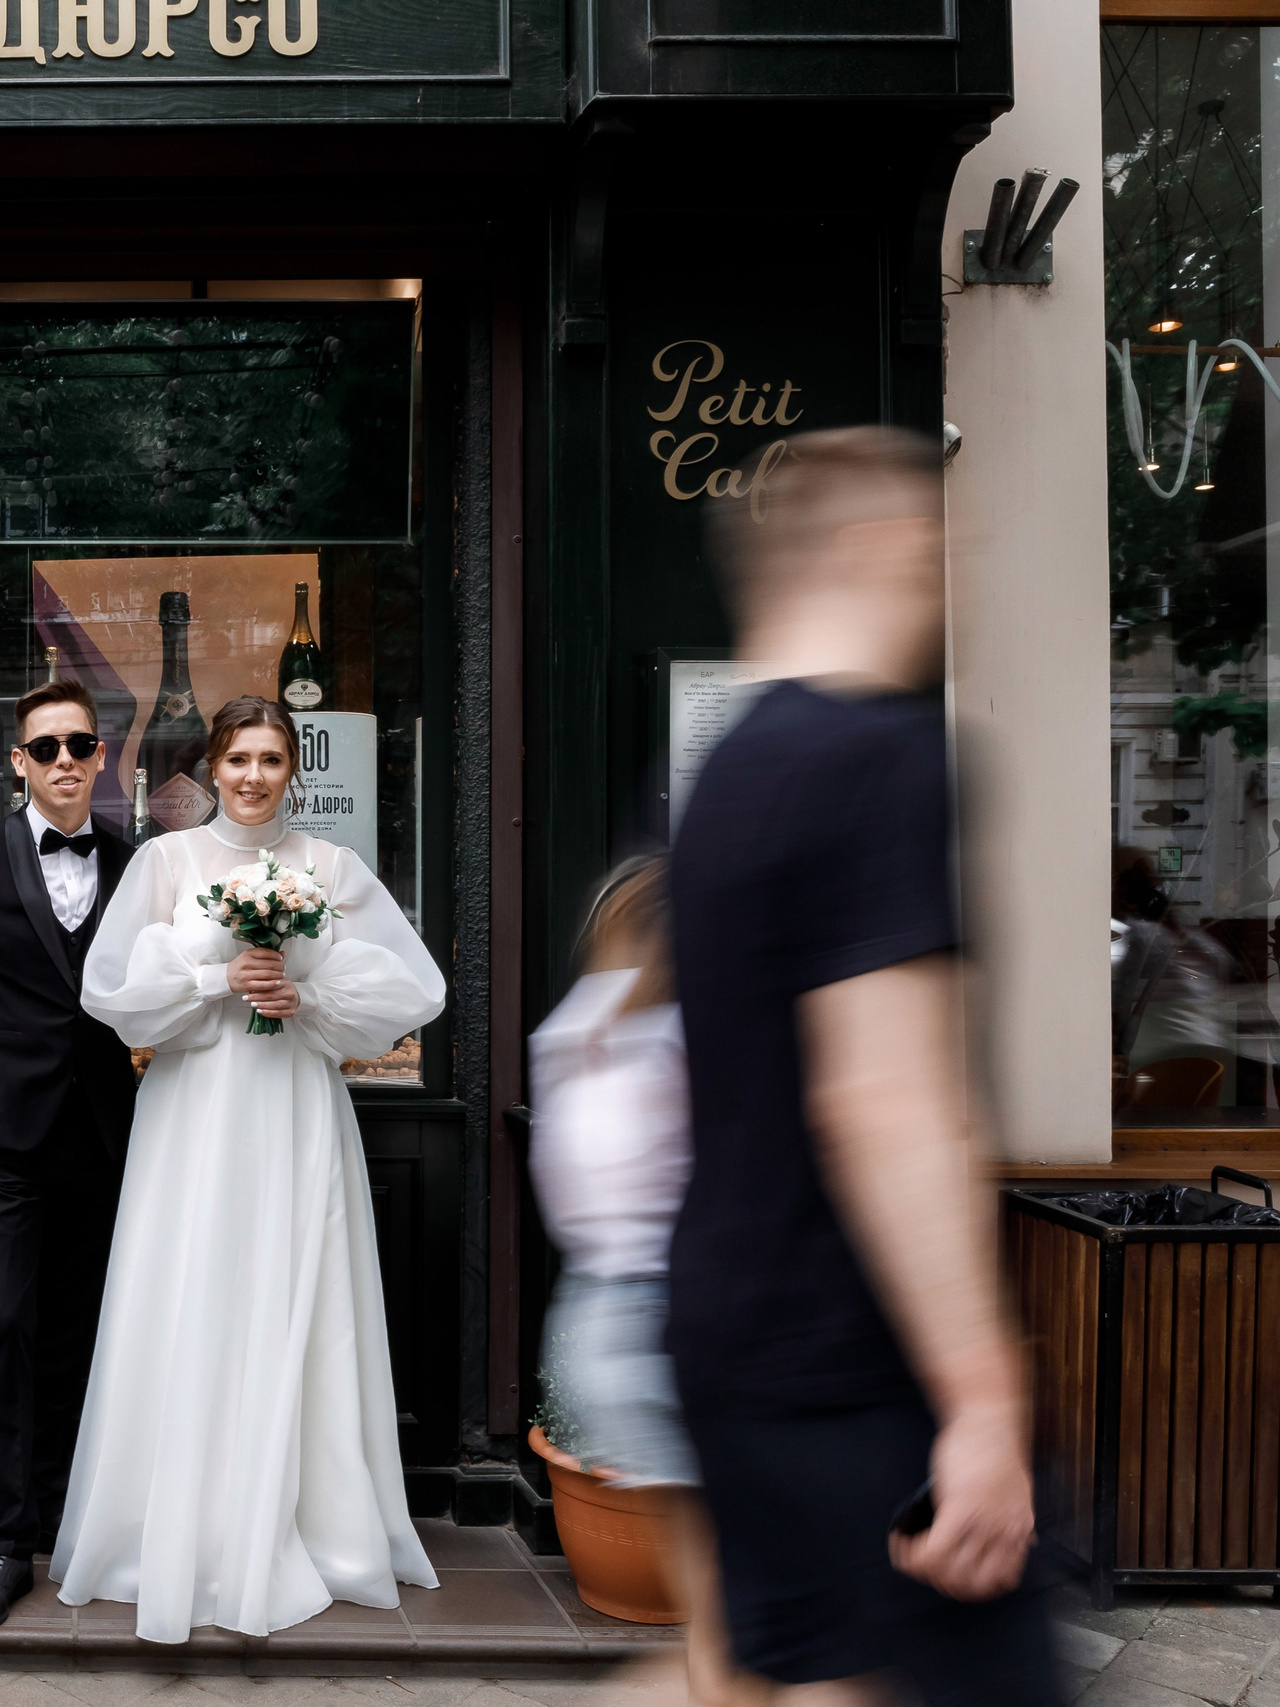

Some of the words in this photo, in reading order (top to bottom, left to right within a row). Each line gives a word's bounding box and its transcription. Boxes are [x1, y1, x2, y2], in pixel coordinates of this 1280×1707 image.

[646, 339, 804, 426] Petit
[649, 430, 804, 525] Caf
[285, 796, 307, 814] РАУ
[311, 795, 354, 815] ДЮРСО
